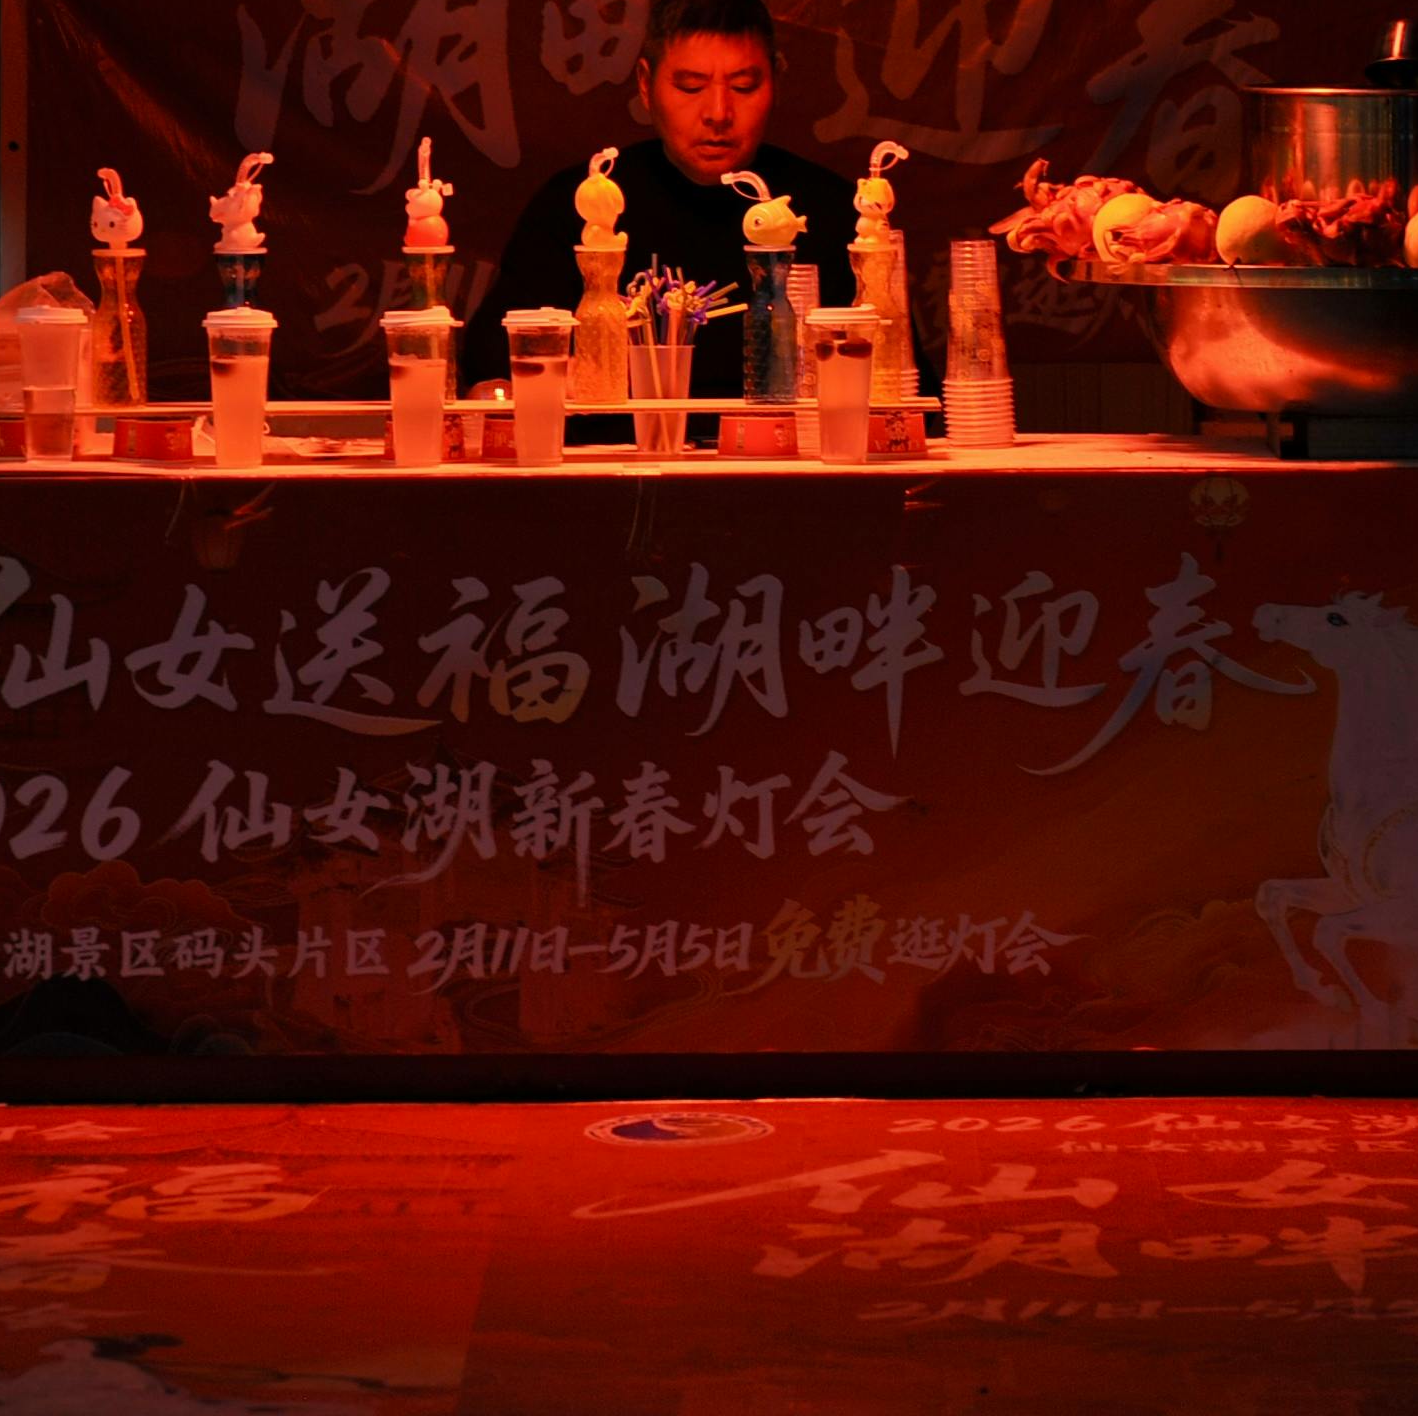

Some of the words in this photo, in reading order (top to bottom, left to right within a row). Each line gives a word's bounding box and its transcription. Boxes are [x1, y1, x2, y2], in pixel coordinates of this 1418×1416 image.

[158, 758, 913, 906] 仙女湖新春灯会
[885, 1114, 1104, 1135] 2026
